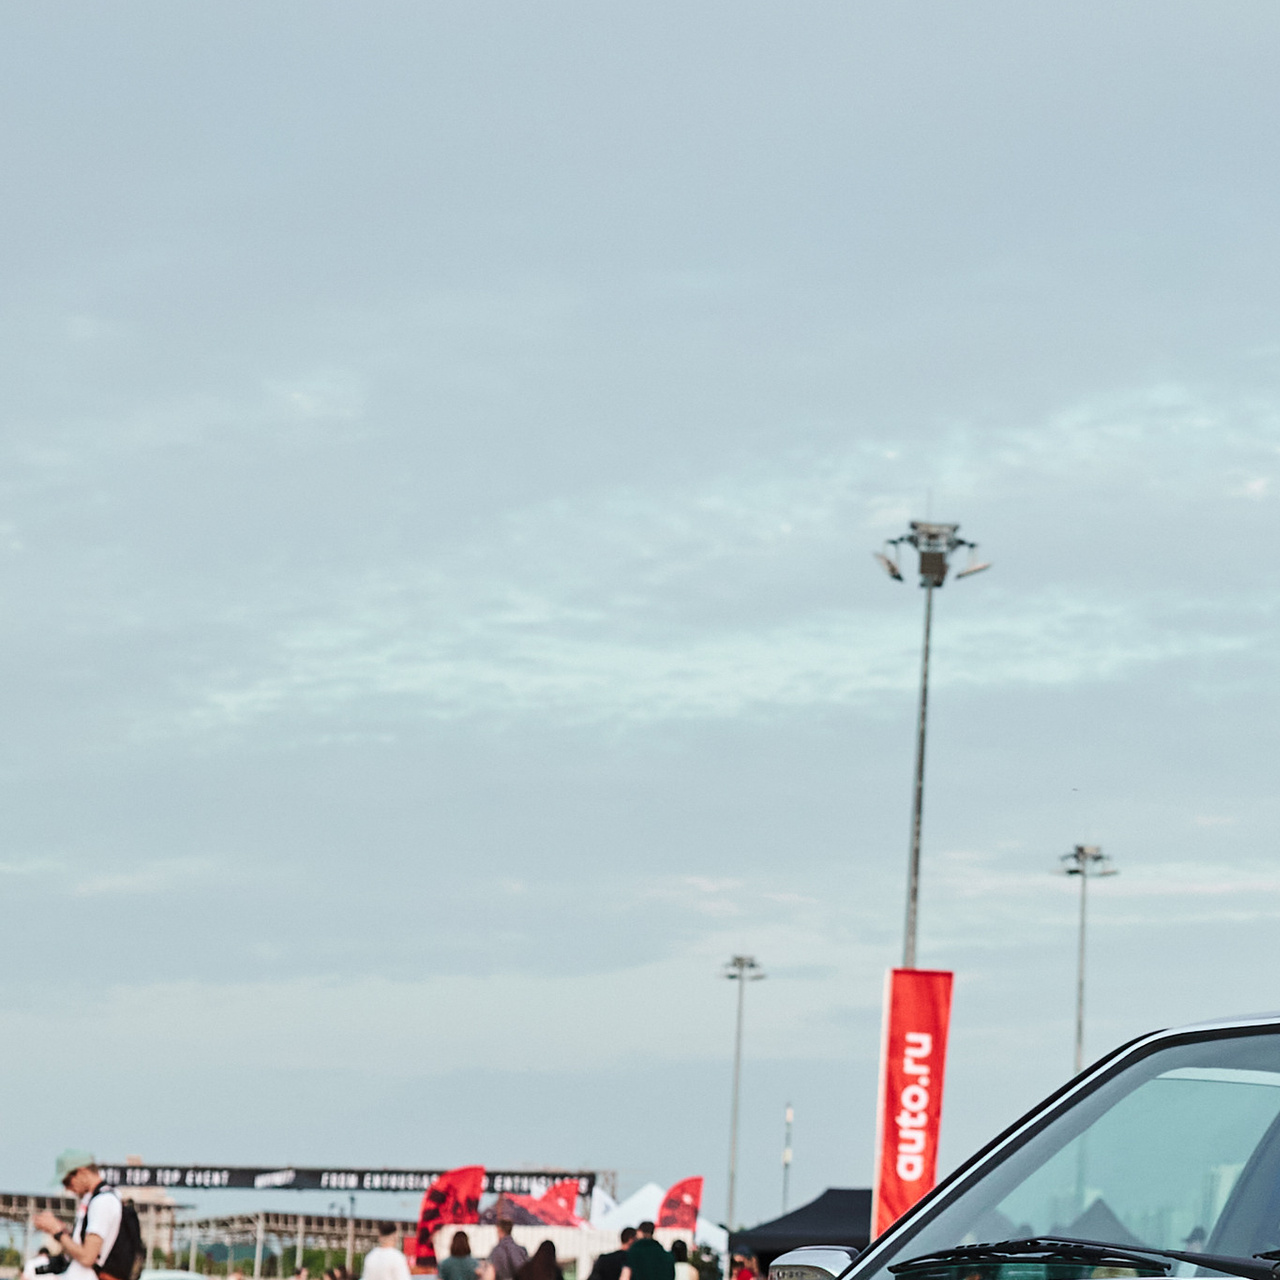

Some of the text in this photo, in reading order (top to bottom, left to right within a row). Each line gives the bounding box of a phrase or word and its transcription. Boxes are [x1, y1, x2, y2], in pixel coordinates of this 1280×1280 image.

[896, 1031, 932, 1182] auto.ru
[185, 1170, 230, 1188] EVENT
[320, 1172, 358, 1189] FROM
